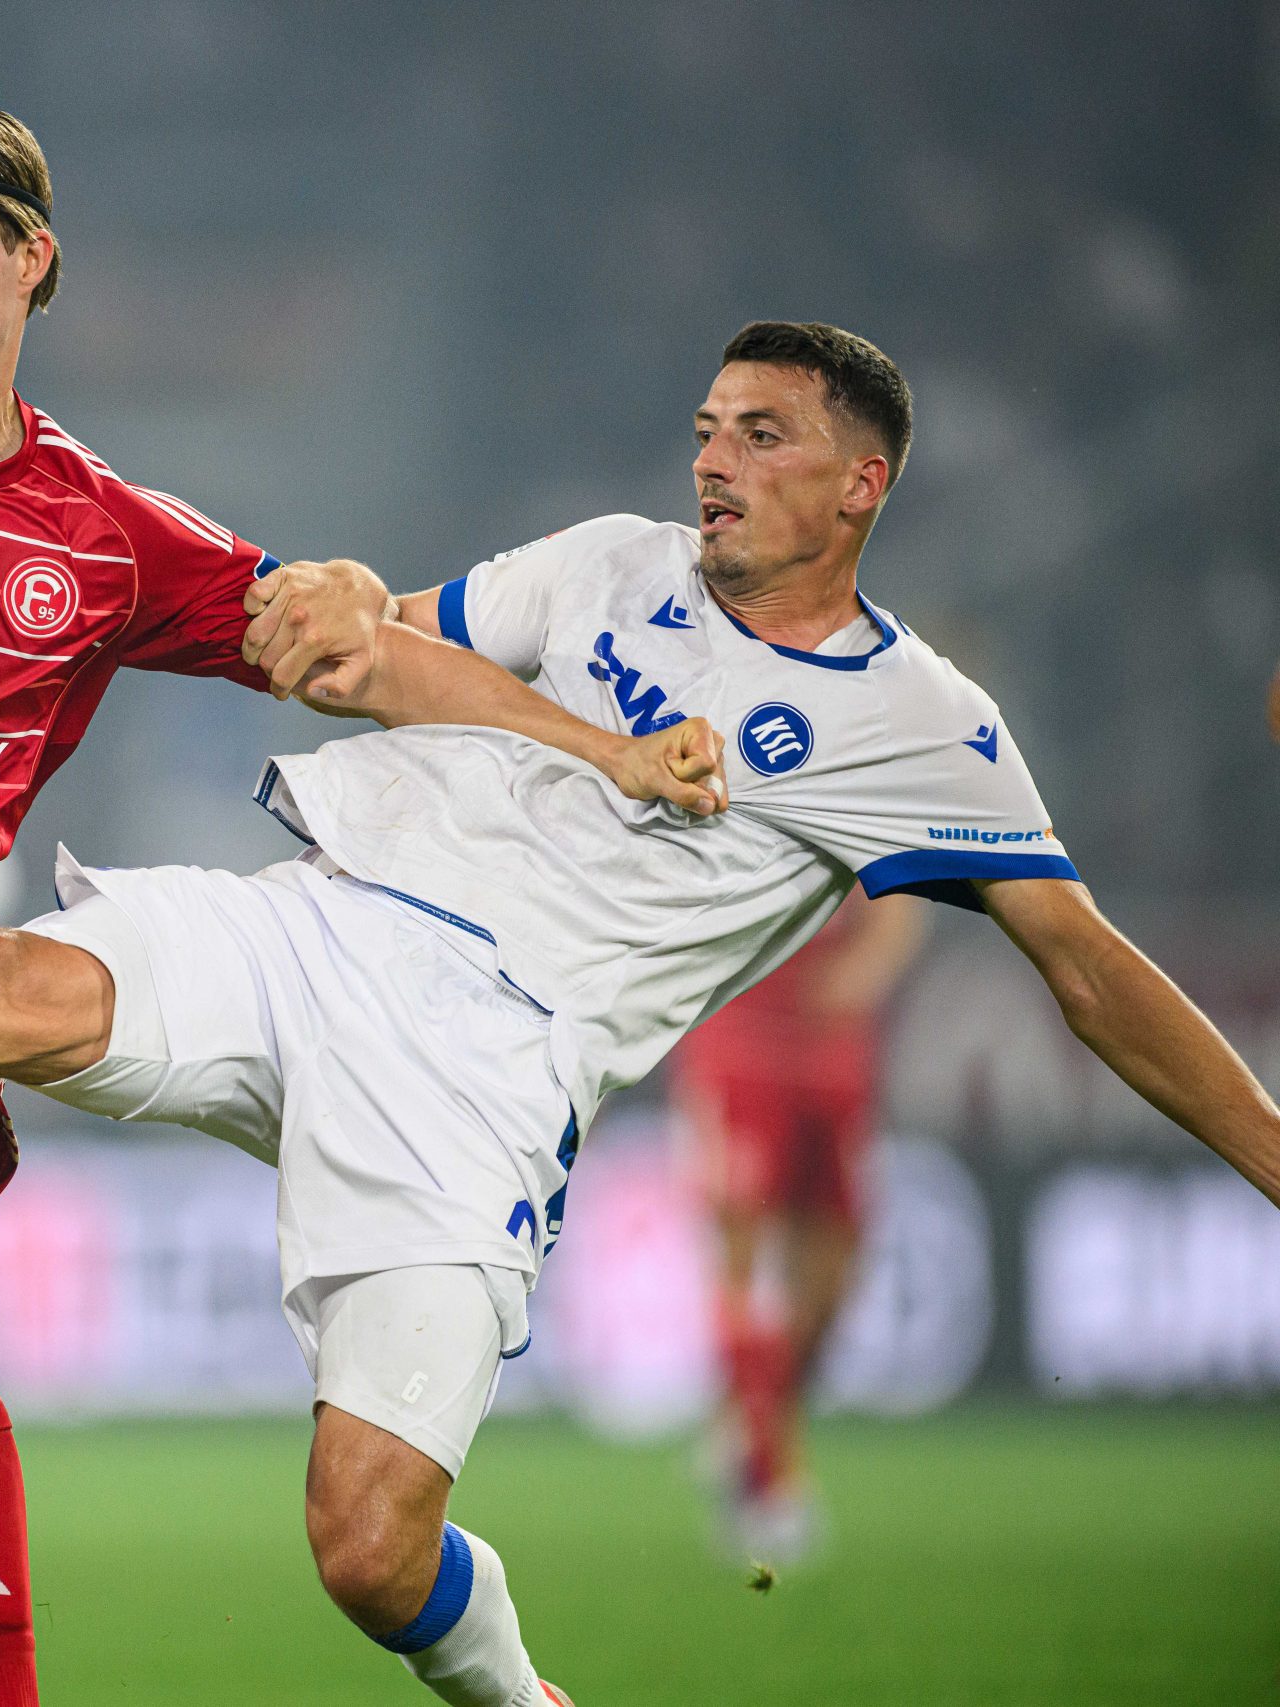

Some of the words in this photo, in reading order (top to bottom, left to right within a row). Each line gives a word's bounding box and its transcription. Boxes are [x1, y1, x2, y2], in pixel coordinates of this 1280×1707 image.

[19, 573, 63, 623] F
[37, 605, 57, 621] 95
[749, 715, 804, 765] KSC
[400, 1369, 430, 1405] 6
